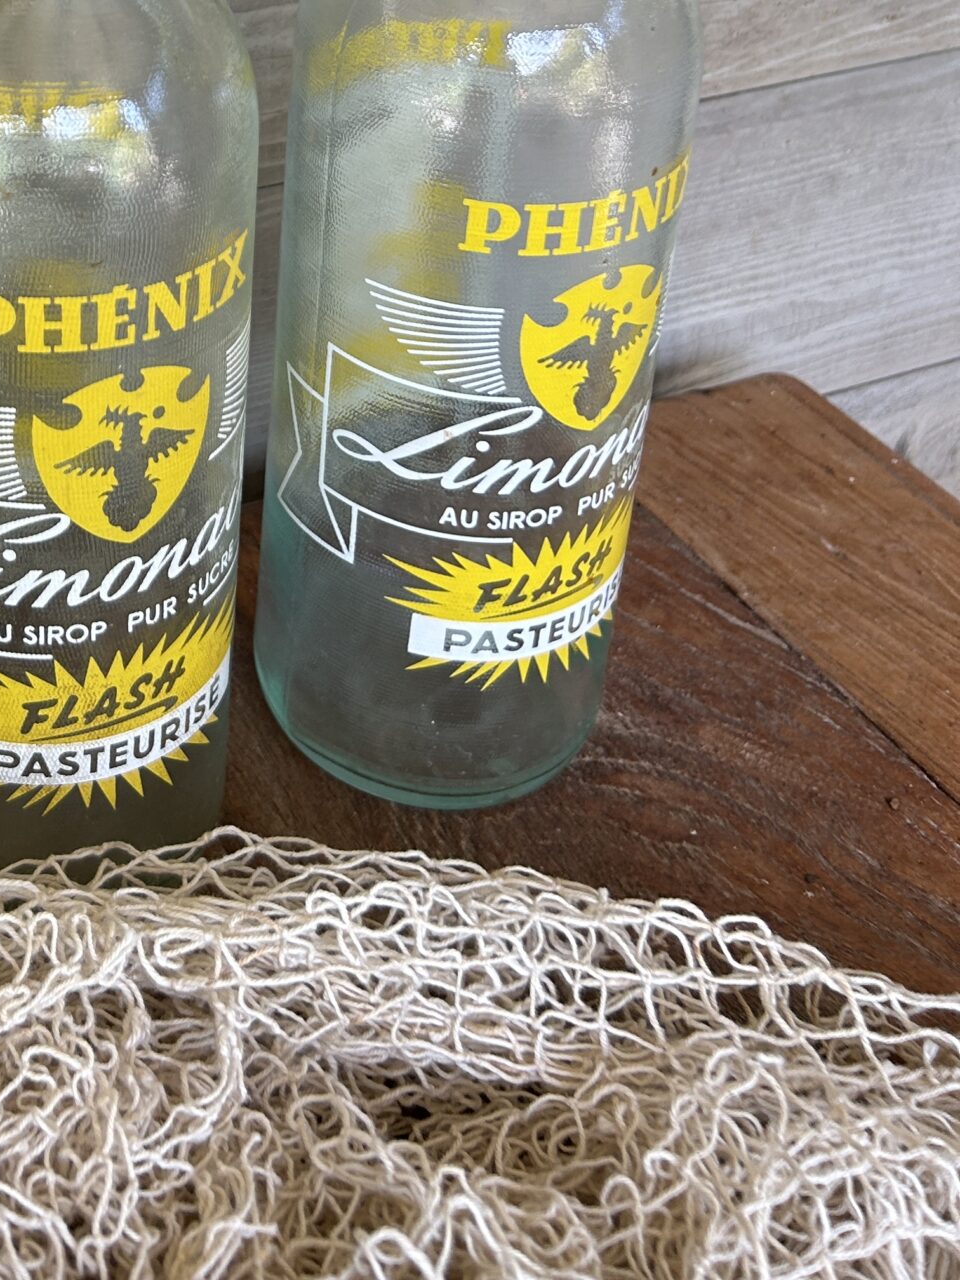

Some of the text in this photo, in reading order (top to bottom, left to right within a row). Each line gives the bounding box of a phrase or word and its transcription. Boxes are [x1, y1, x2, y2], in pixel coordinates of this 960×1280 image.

[438, 481, 616, 530] AU SIROP PUR
[22, 620, 108, 646] SIROP
[127, 596, 177, 633] PUR
[186, 538, 234, 604] SUCRE
[442, 566, 621, 655] PASTEURIS
[472, 535, 613, 614] FLASH
[19, 654, 187, 735] FLASH
